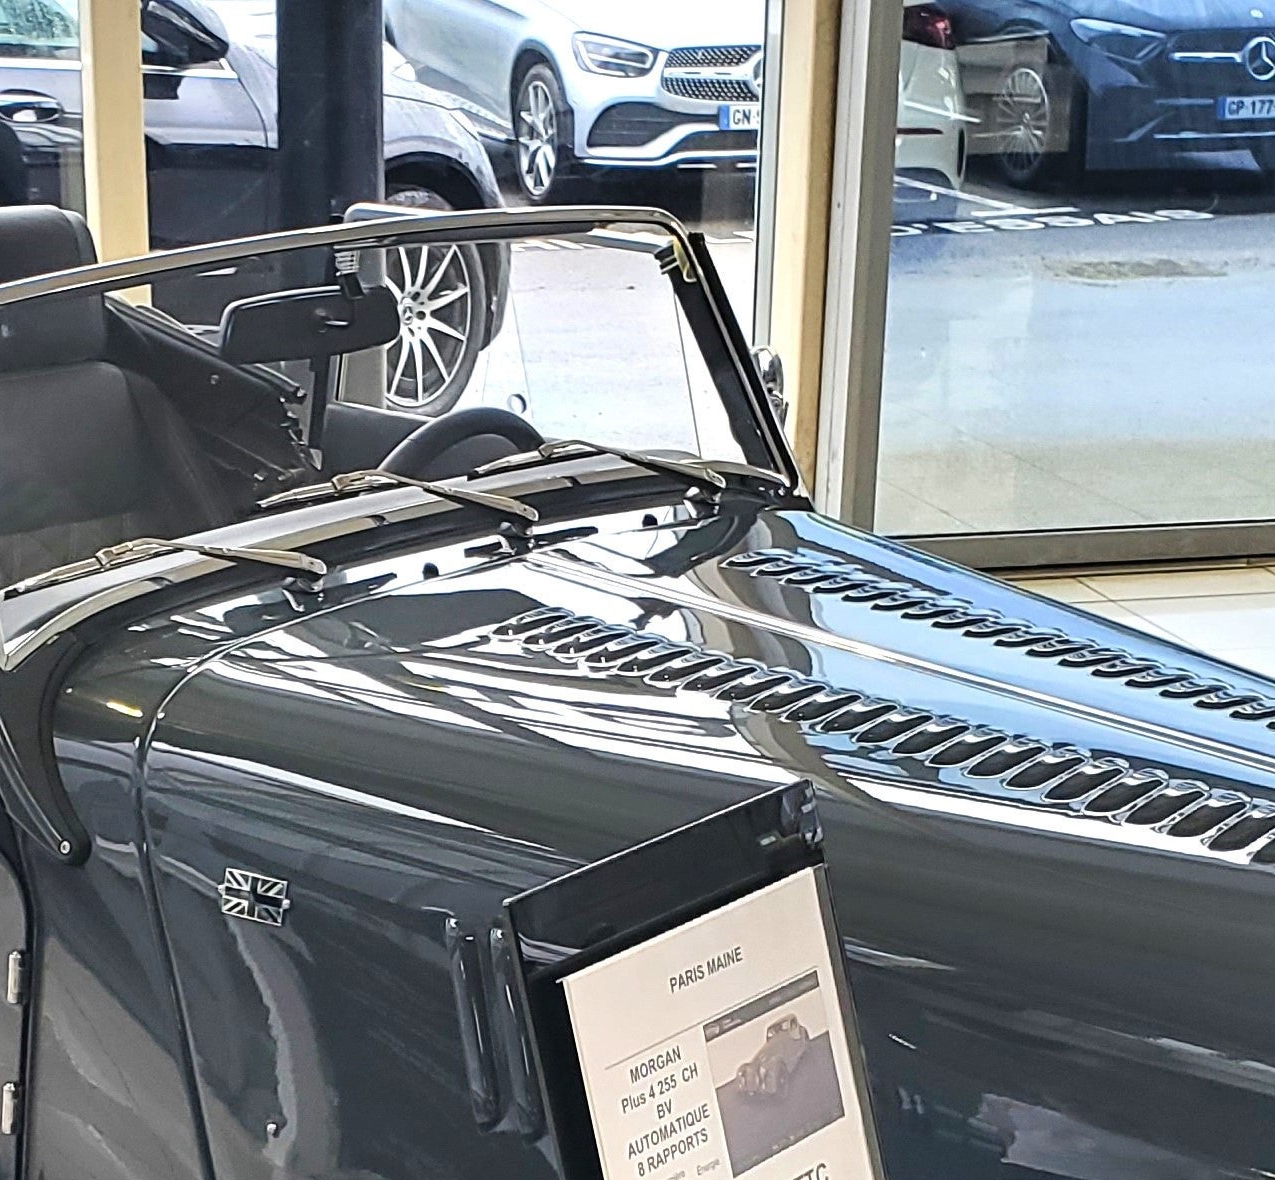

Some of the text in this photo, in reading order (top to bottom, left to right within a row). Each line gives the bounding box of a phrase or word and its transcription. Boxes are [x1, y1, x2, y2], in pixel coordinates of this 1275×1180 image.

[669, 946, 743, 994] PARIS MAINE
[621, 1062, 699, 1115] Plus 4 255 CH
[629, 1045, 682, 1084] MORGAN
[628, 1102, 711, 1160] AUTOMATIQUE
[656, 1098, 672, 1120] BV
[637, 1127, 709, 1177] 8 RAPPORTS
